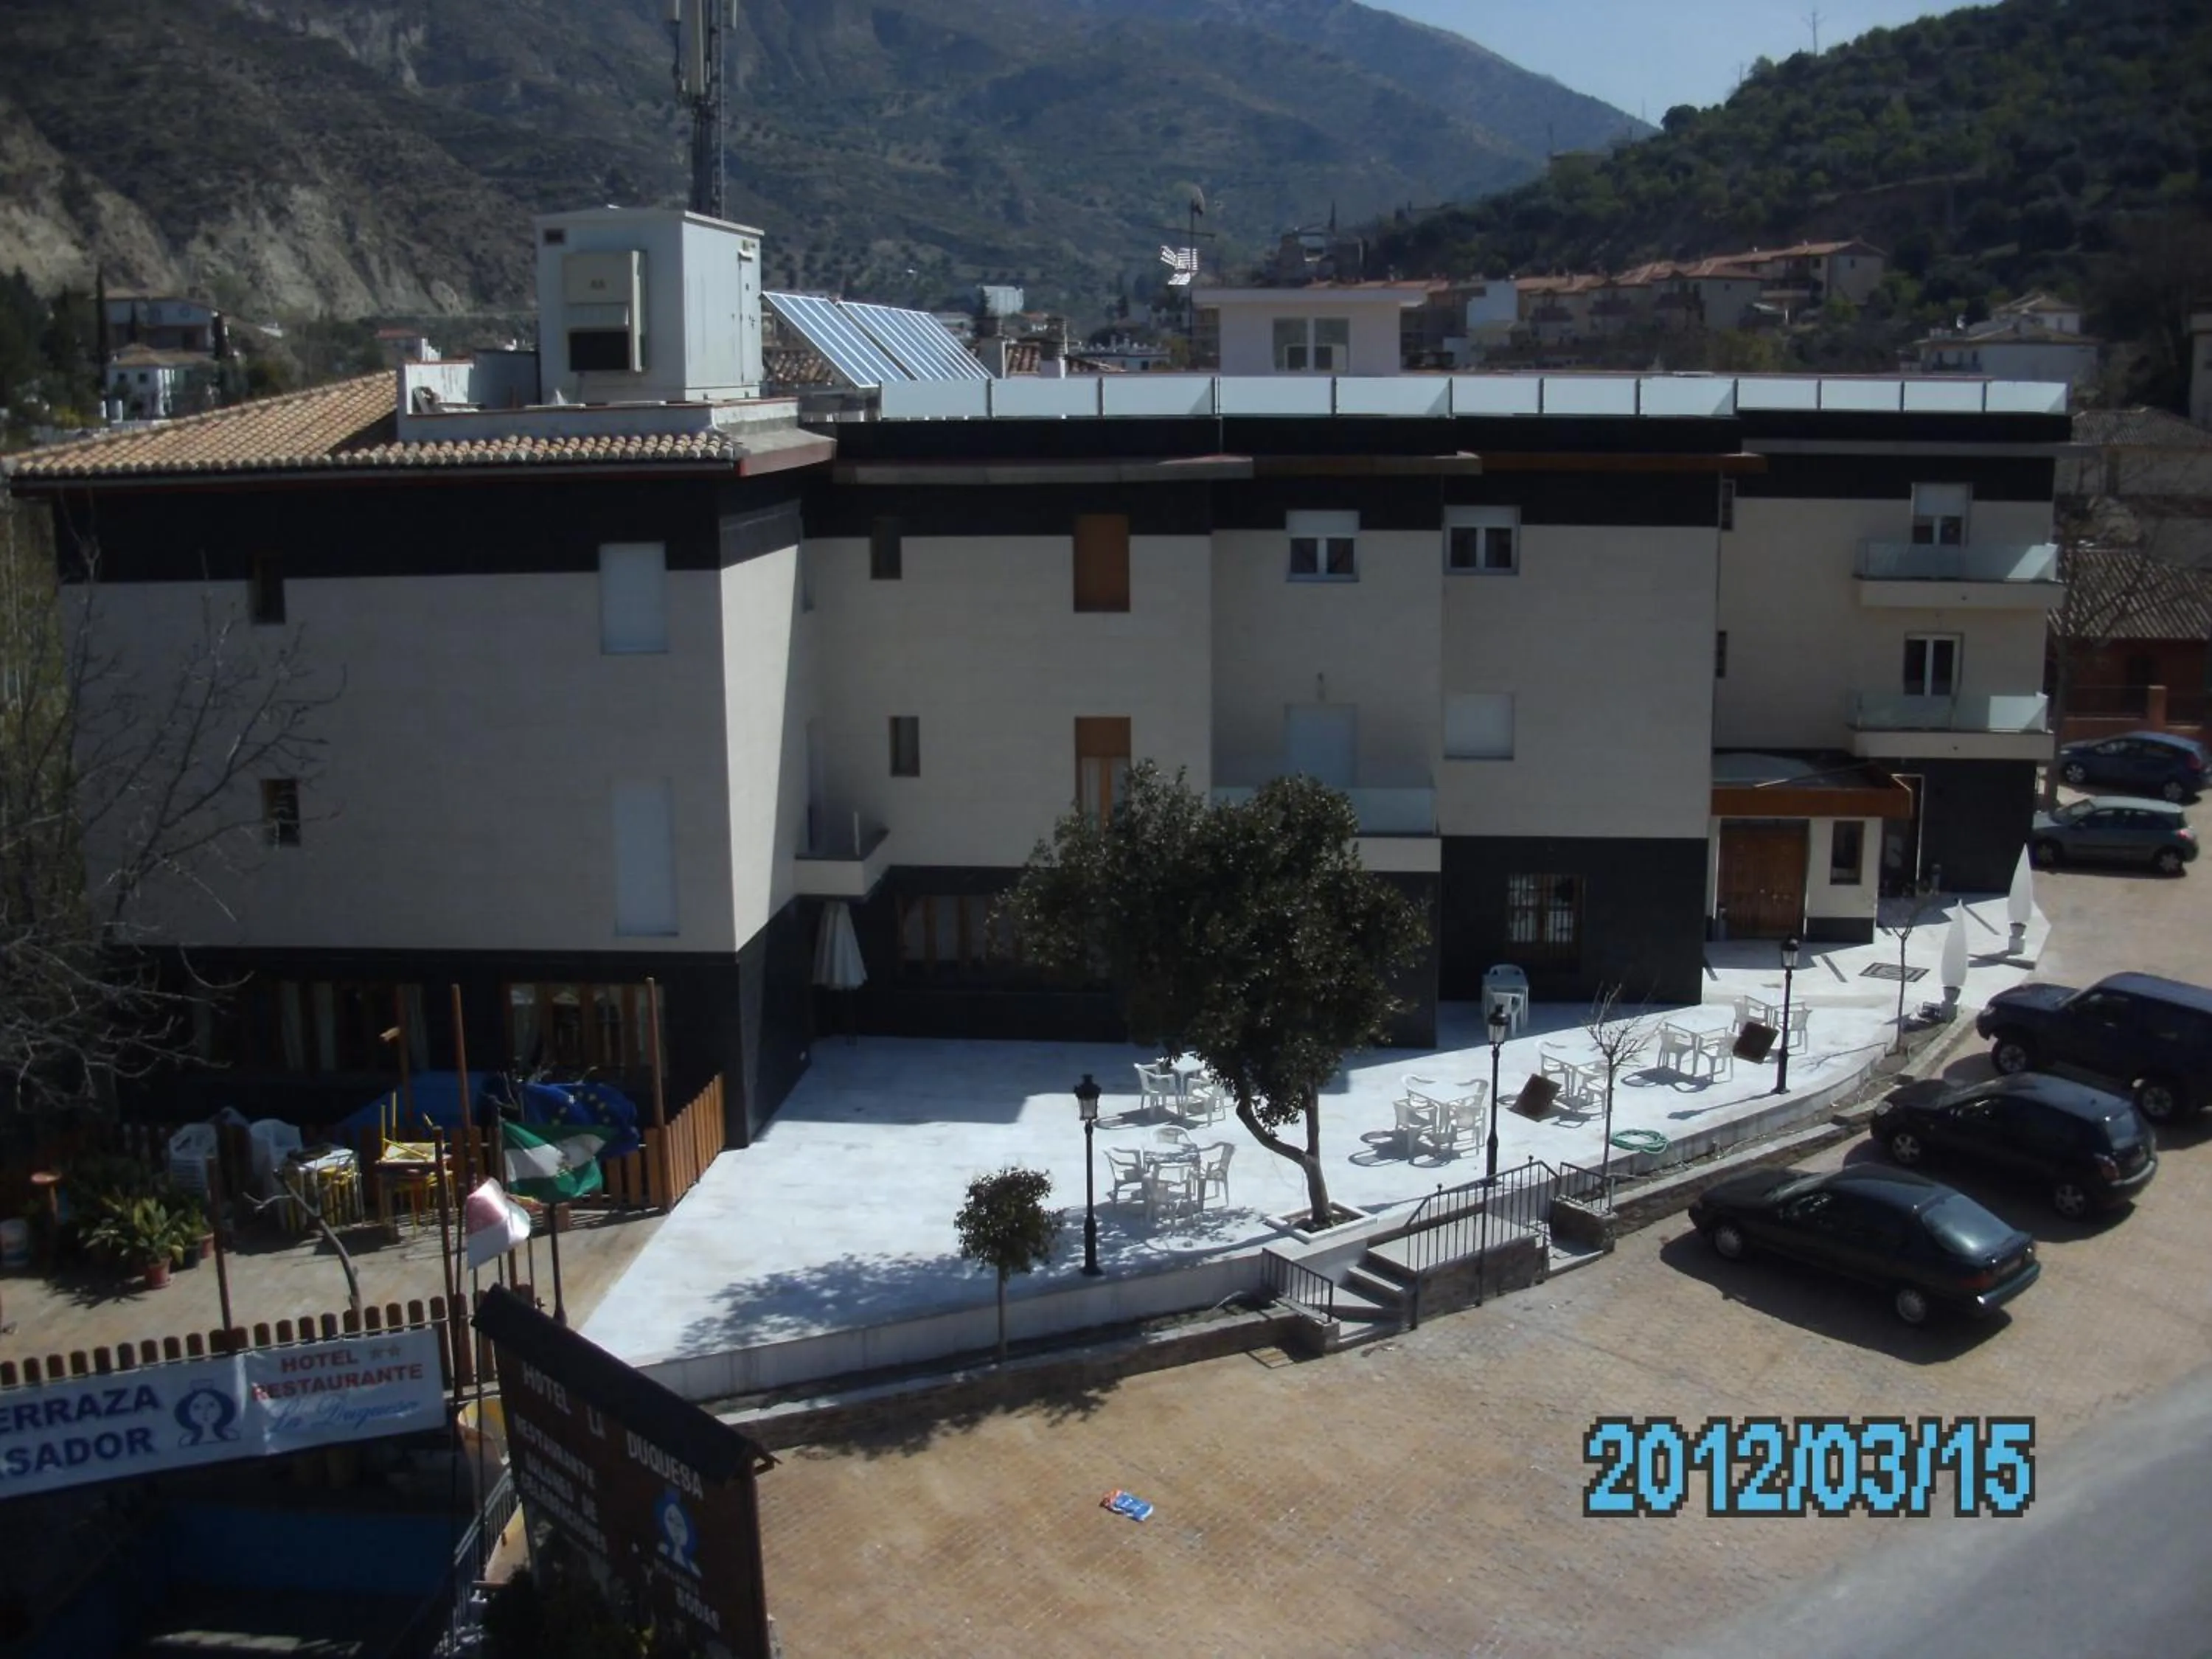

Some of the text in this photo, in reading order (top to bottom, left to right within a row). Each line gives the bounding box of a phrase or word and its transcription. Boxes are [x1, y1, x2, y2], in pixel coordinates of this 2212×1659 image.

[251, 1363, 423, 1402] RESTAURANTE
[281, 1348, 359, 1374] HOTEL
[0, 1427, 155, 1479] SADOR
[521, 1360, 572, 1416] HOTEL
[626, 1430, 704, 1501] DUQUESA
